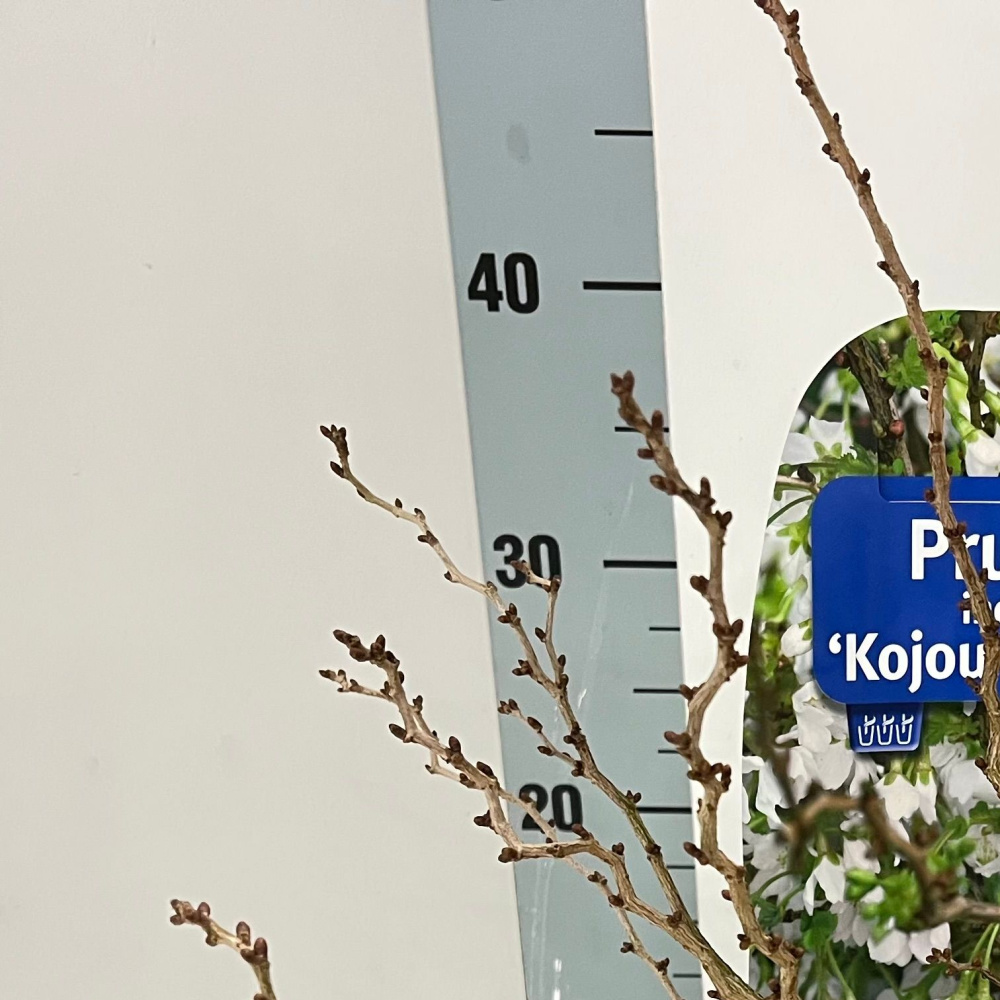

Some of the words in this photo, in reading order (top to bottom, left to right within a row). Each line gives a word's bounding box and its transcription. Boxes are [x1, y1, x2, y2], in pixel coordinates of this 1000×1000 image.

[467, 252, 540, 314] 40
[493, 534, 561, 589] 30
[519, 783, 583, 832] 20
